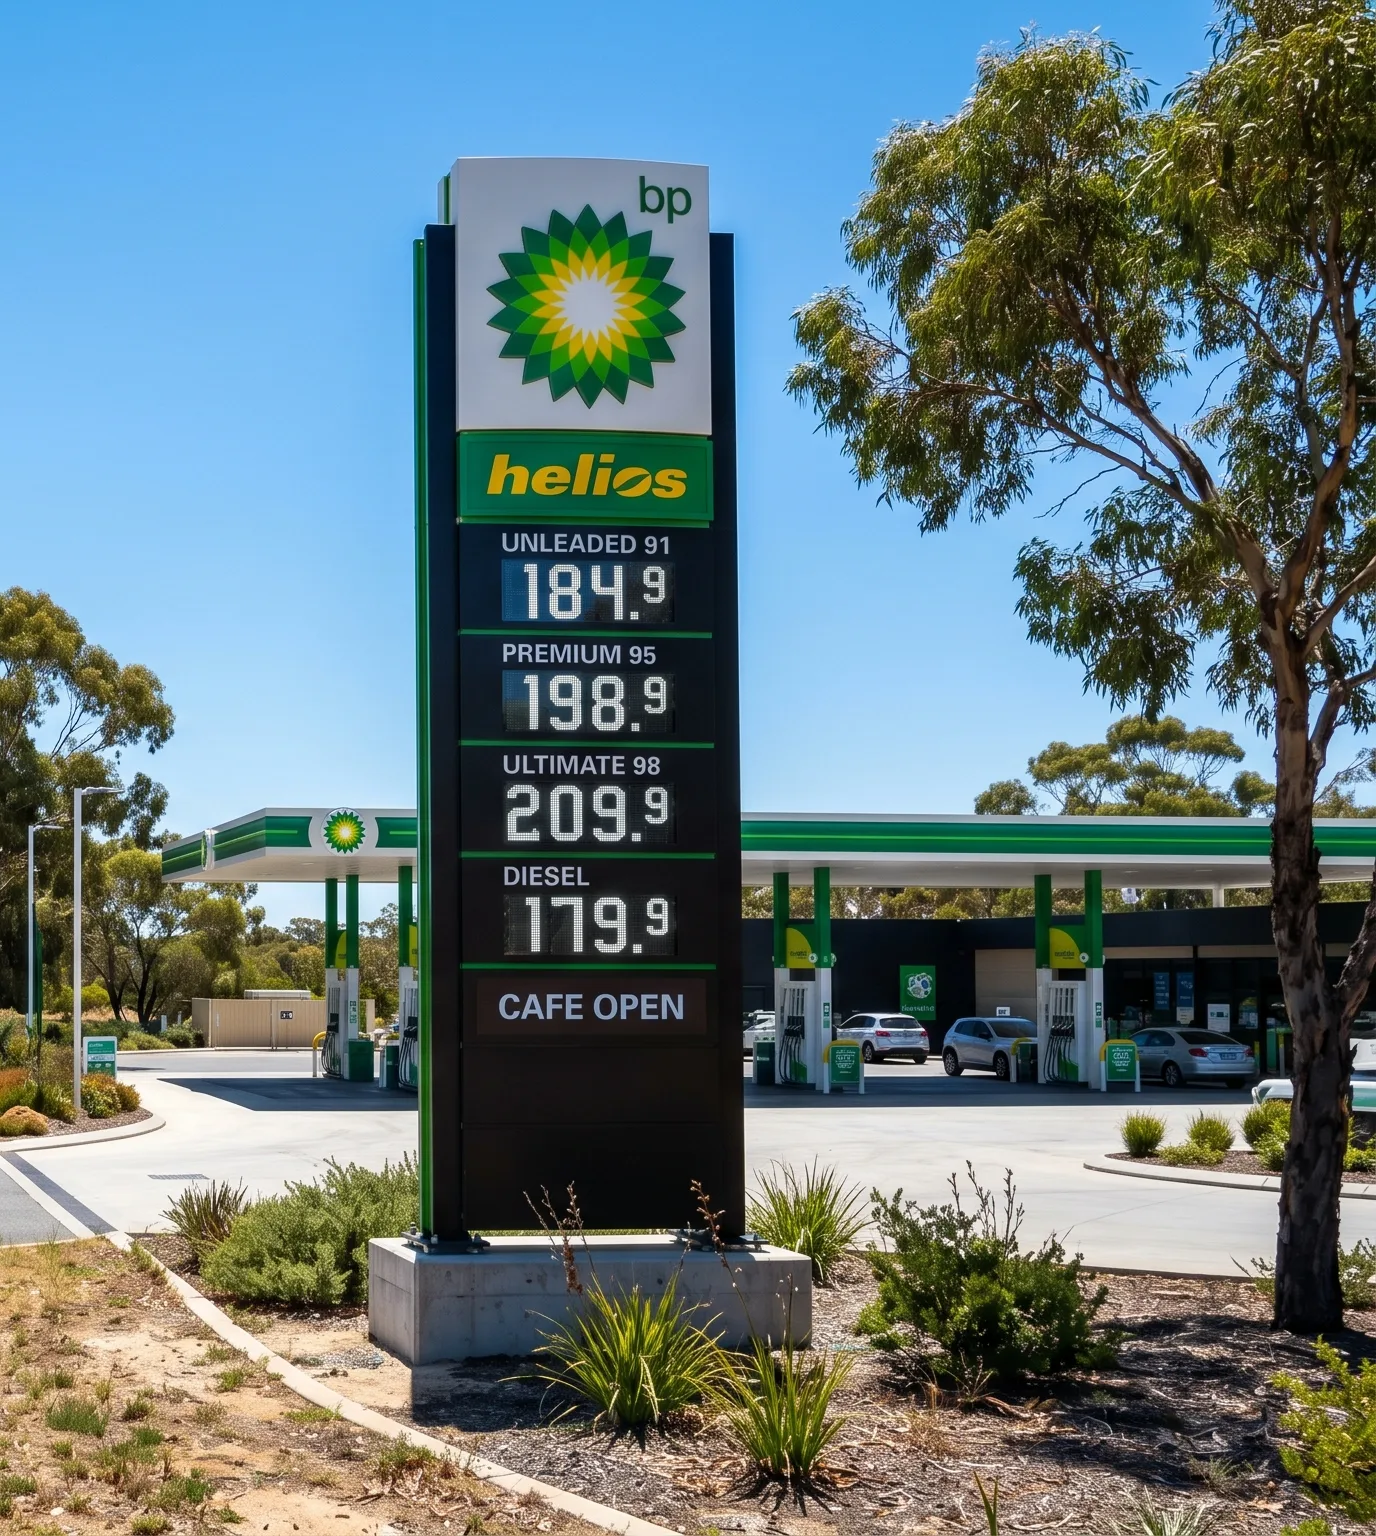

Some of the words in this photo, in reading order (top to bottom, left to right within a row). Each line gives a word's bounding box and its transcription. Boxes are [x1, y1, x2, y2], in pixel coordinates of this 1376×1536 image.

[638, 175, 692, 224] bp
[486, 453, 688, 499] helios
[501, 532, 636, 554] UNLEADED
[643, 535, 670, 555] 91
[523, 563, 666, 620] 184.9
[502, 643, 621, 664] PREMIUM
[628, 645, 657, 665] 95
[523, 674, 667, 732] 198.9
[503, 754, 626, 775] ULTIMATE
[632, 755, 661, 776] 98
[506, 784, 669, 842] 209.9
[503, 866, 590, 886] DIESEL
[525, 896, 669, 954] 179.9
[498, 993, 584, 1020] CAFE
[593, 993, 685, 1020] OPEN
